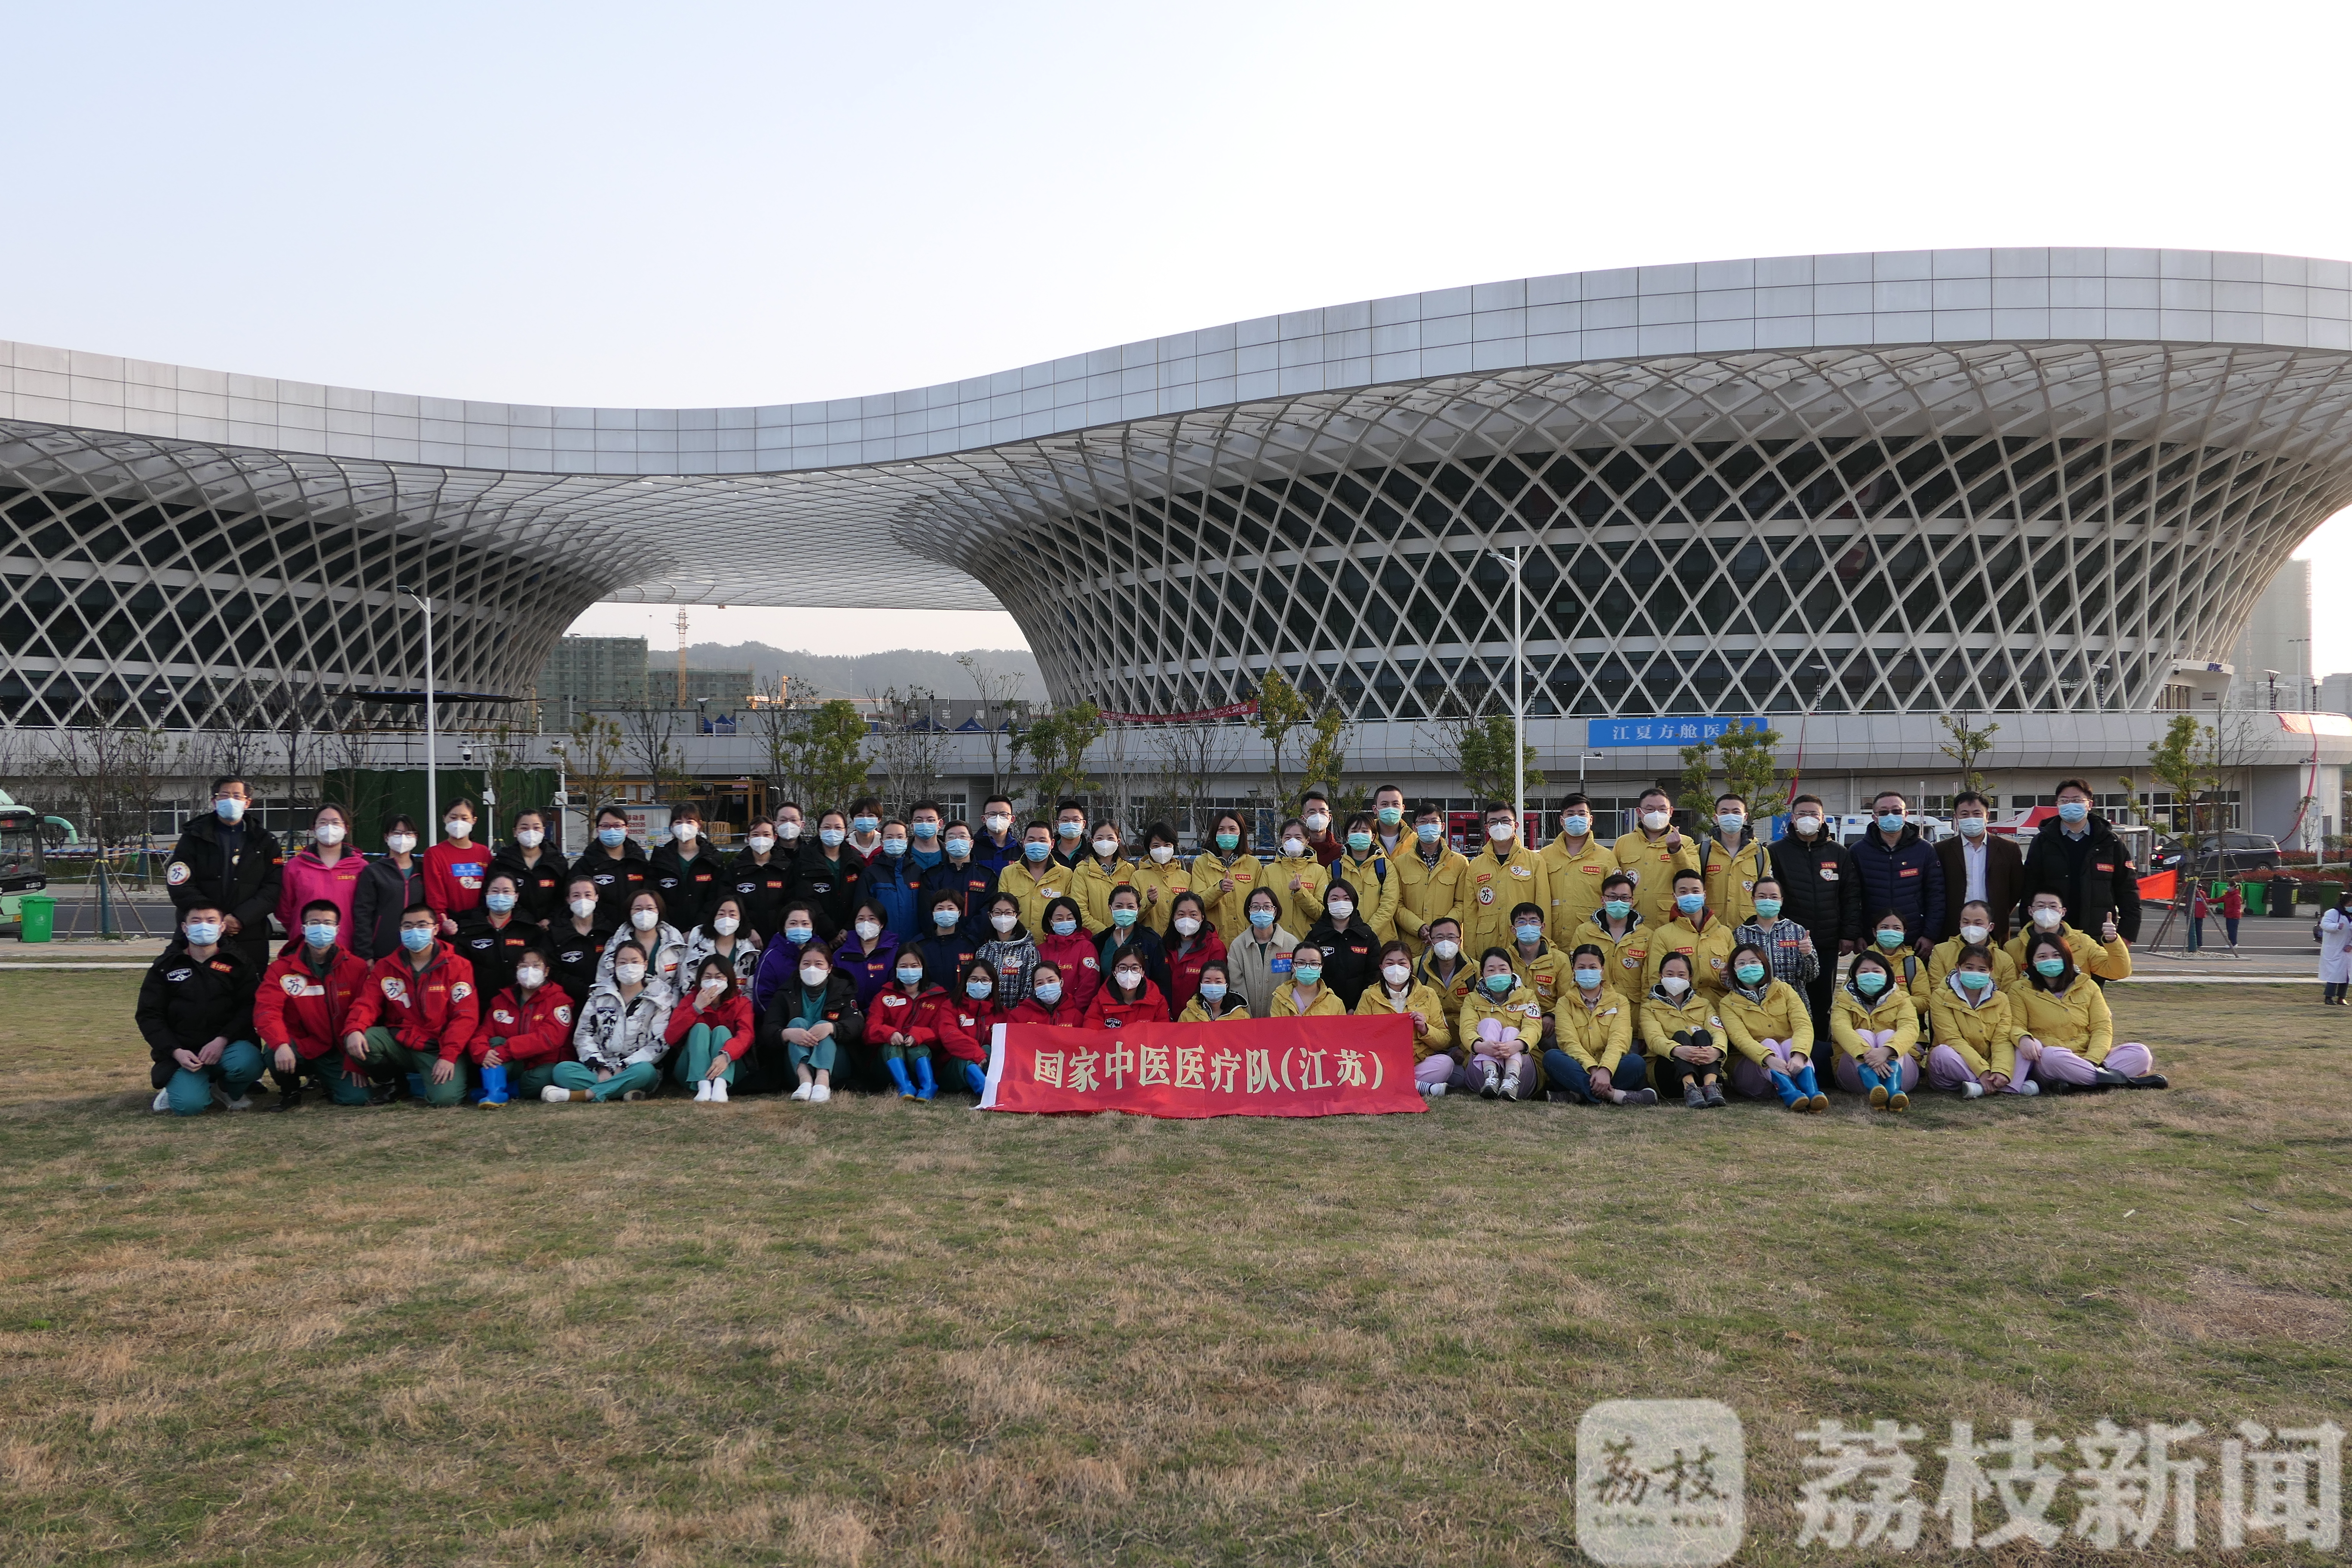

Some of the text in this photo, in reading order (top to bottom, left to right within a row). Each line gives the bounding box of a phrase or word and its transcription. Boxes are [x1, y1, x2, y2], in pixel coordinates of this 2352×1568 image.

[171, 866, 184, 880] 苏
[1481, 888, 1491, 902] 苏
[287, 977, 301, 993] 苏
[386, 982, 399, 996] 苏
[1528, 1004, 1539, 1015] 苏
[1034, 1041, 1383, 1094] 国家中医医疗队(江苏)
